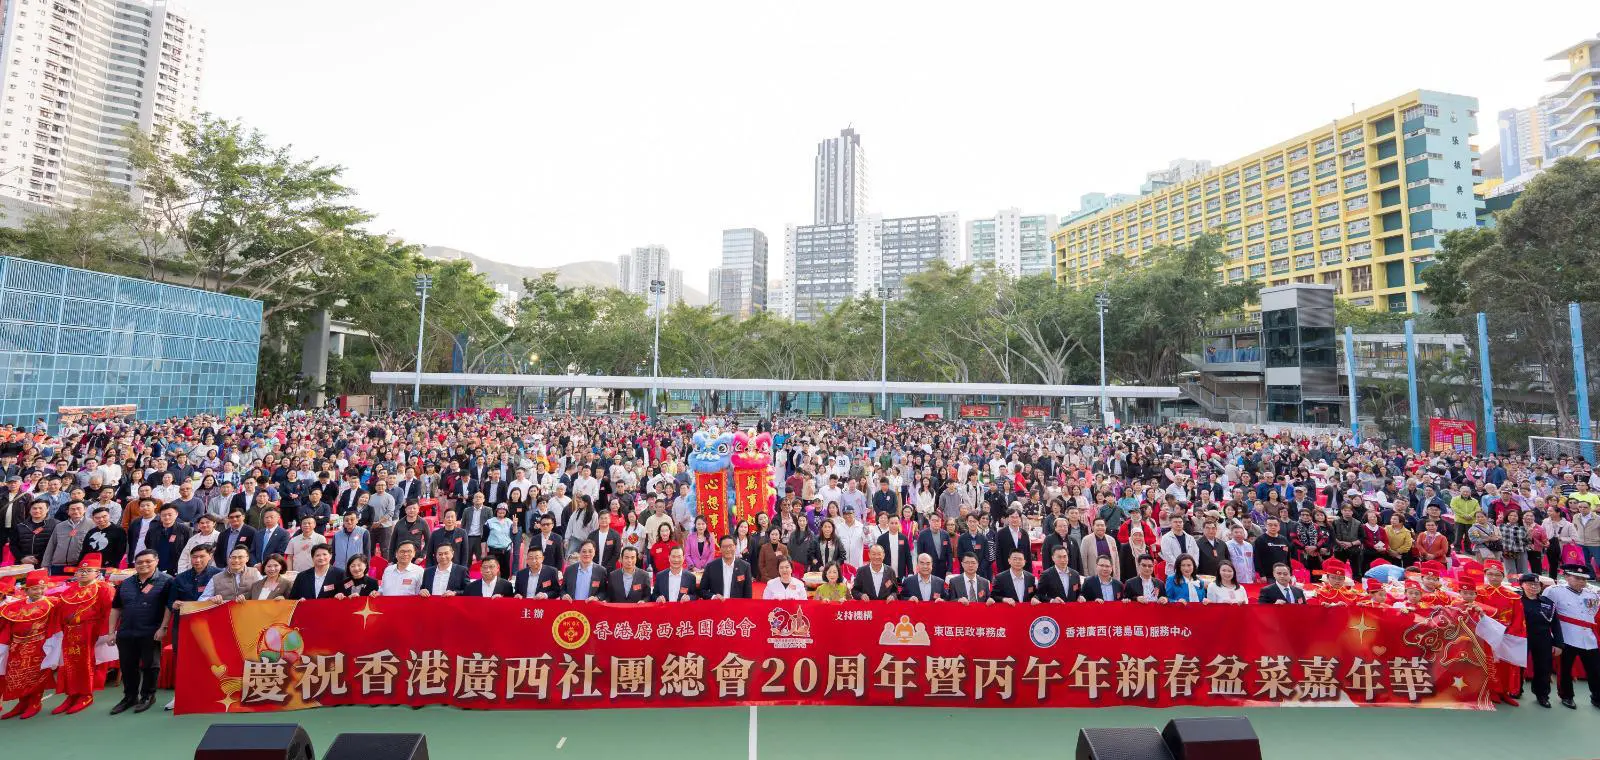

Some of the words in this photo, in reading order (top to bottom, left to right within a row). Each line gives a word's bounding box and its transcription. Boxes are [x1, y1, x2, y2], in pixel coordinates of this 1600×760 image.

[745, 475, 758, 534] 萬事如
[520, 607, 545, 620] 主辦
[835, 610, 873, 621] 支持機構
[593, 617, 757, 641] 香港廣西社團總會
[933, 625, 1007, 638] 東區民政事務處
[1065, 625, 1192, 639] 香港廣西(港島區)服務中心
[241, 651, 1434, 702] 慶祝香港廣西社團總會20周年暨丙午年新春盆菜嘉年華
